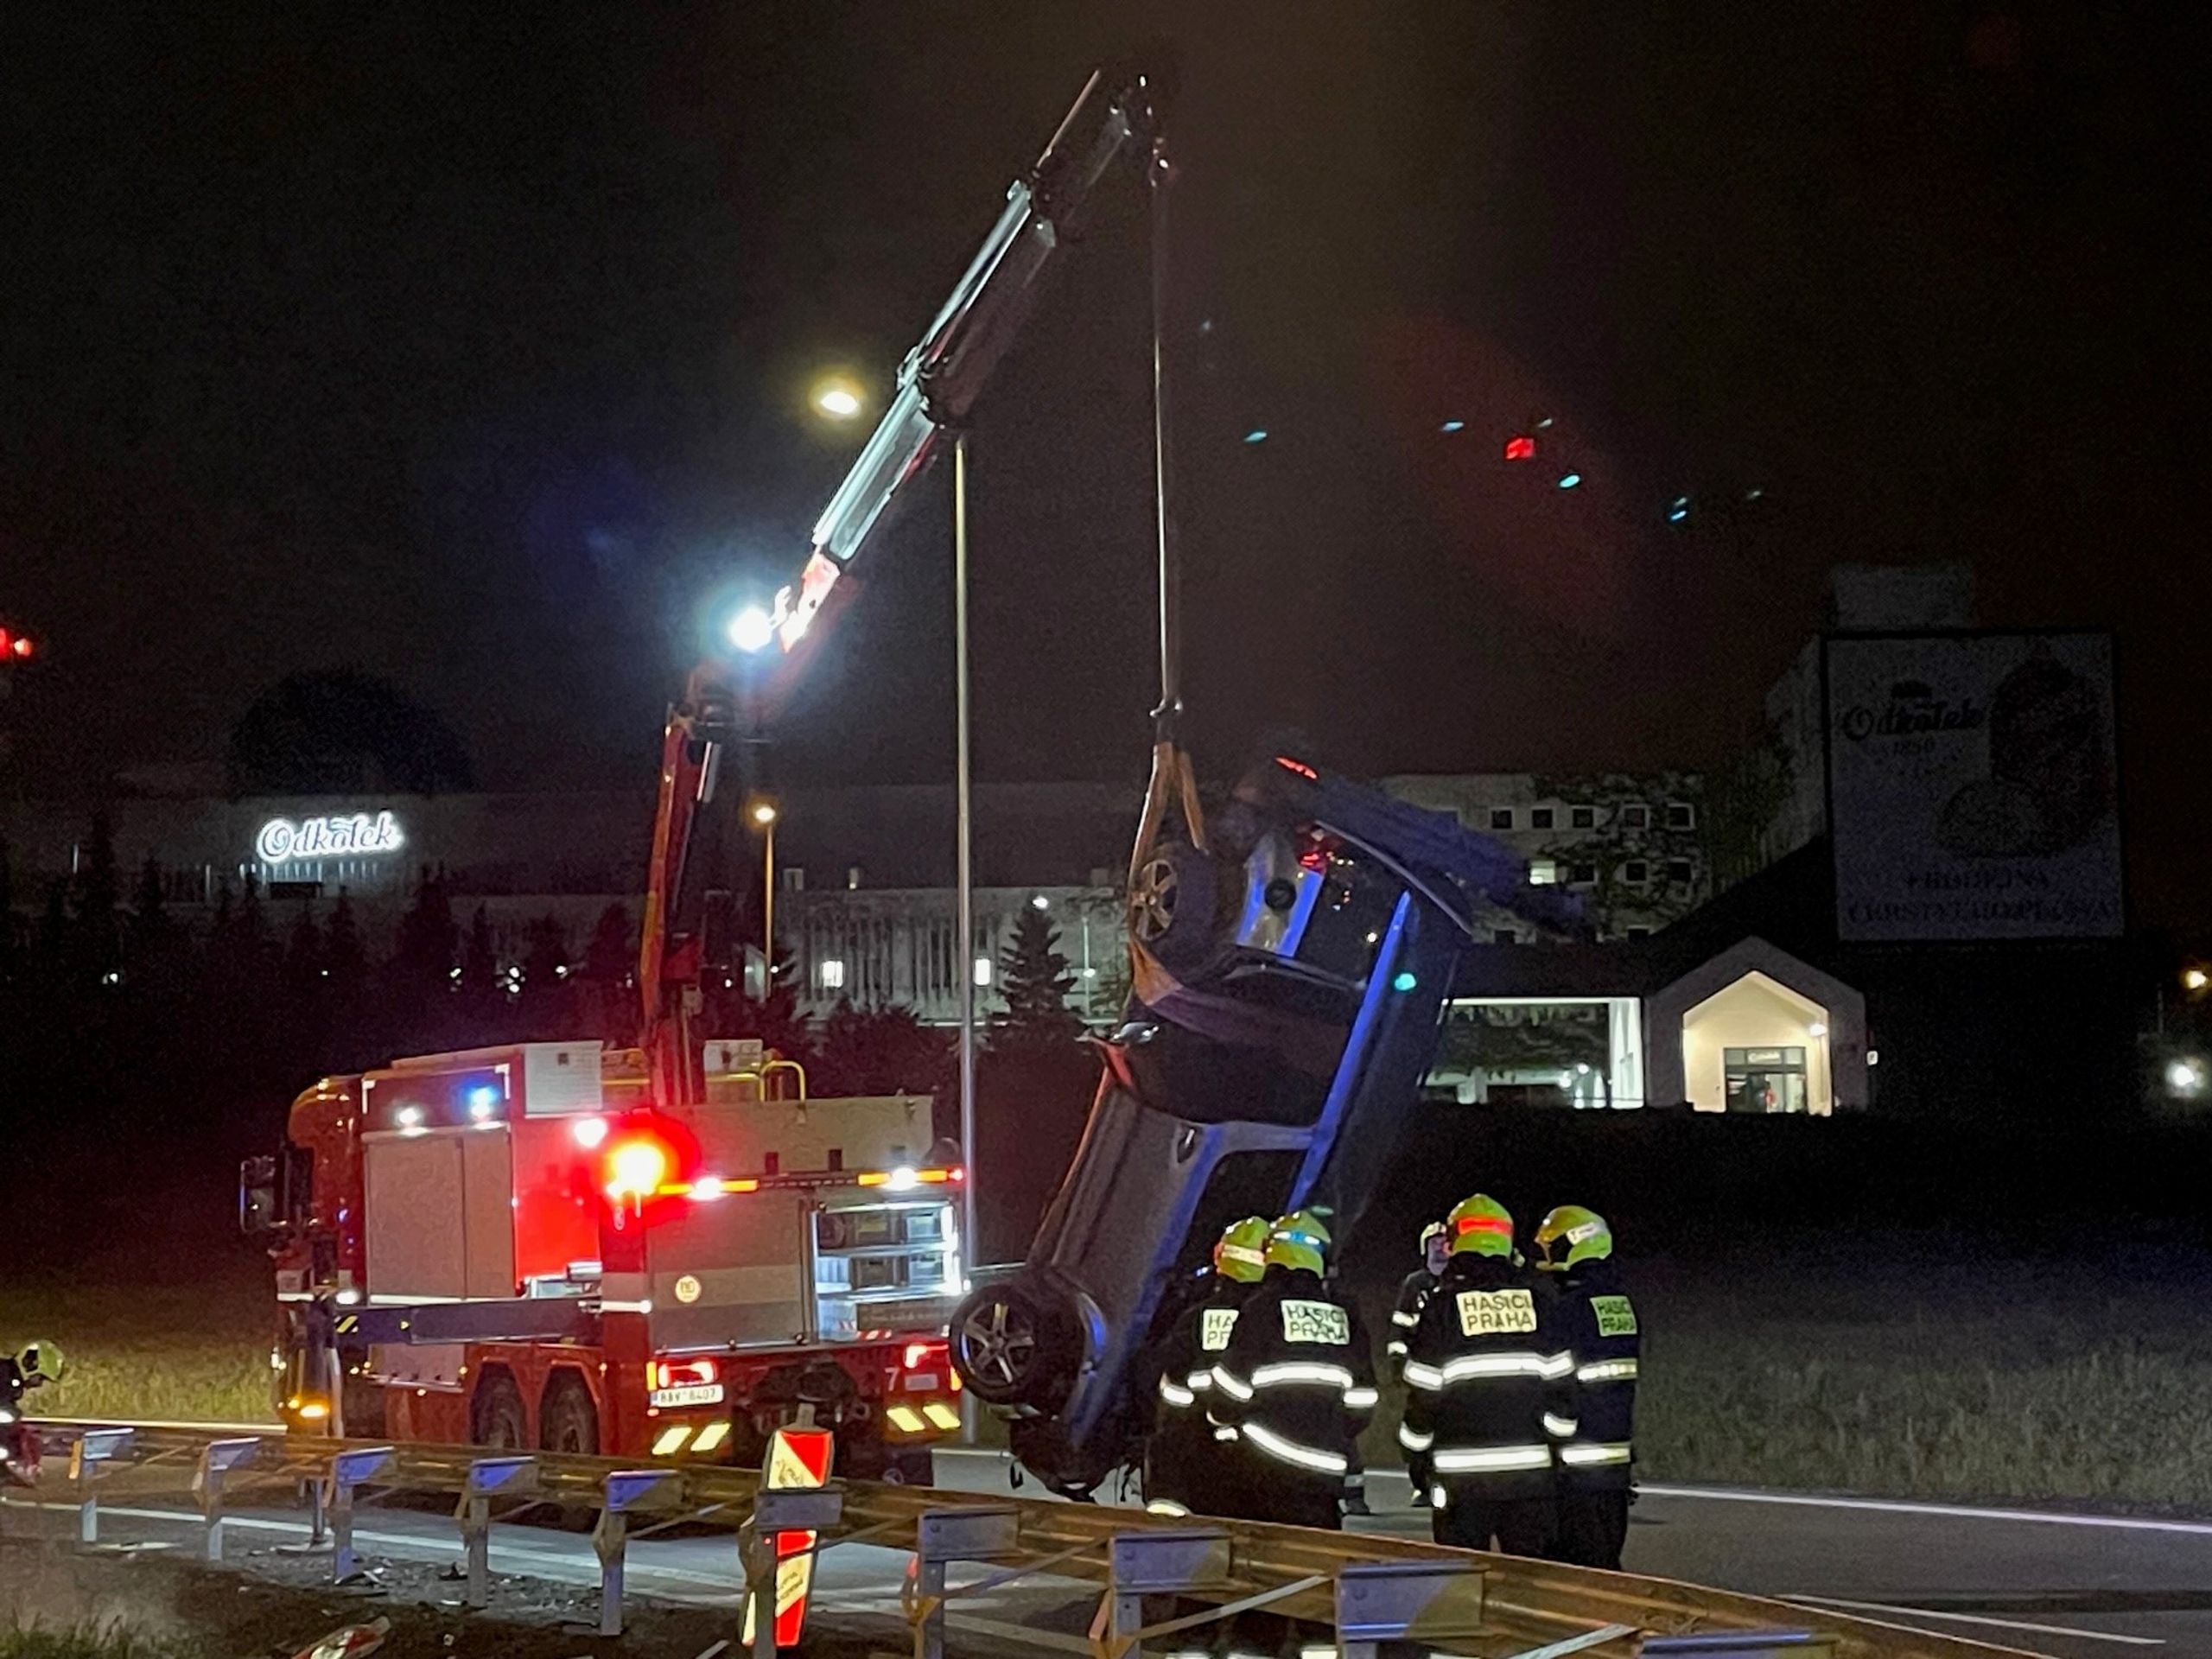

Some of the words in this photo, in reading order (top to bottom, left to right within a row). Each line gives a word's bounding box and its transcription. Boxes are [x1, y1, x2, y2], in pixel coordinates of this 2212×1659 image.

[257, 810, 404, 862] Odkolek
[1467, 1312, 1533, 1330] PRAHA
[885, 1367, 899, 1391] 7
